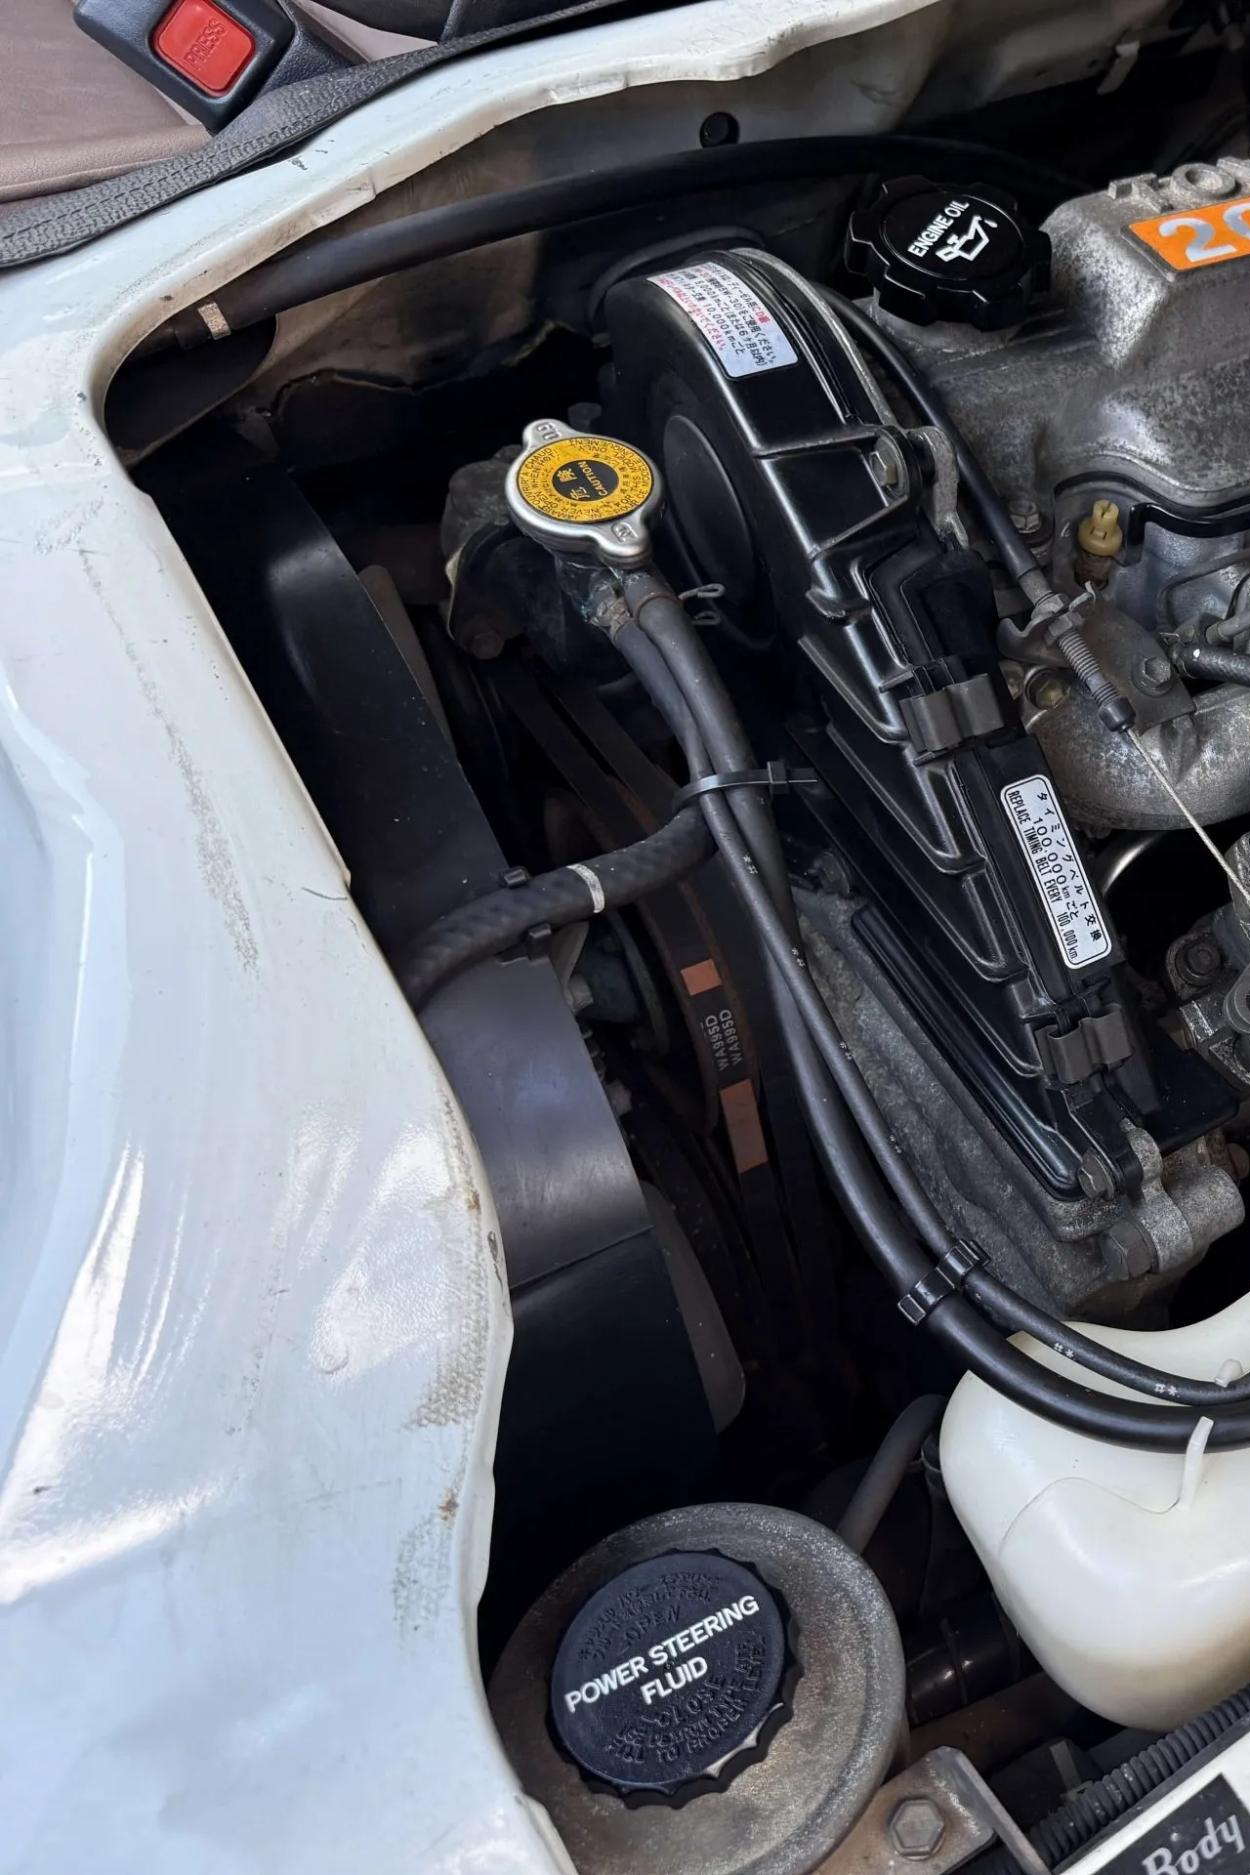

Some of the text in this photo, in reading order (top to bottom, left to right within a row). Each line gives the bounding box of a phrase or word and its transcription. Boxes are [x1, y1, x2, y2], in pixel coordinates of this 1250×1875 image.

[182, 16, 228, 71] PRESS
[907, 199, 970, 257] ENGINE OIL
[534, 490, 559, 509] OPEN
[579, 461, 608, 495] CAUTION
[1007, 789, 1030, 824] REPLACE
[1022, 826, 1042, 855] TIMING
[1034, 856, 1051, 877] BELT
[1037, 791, 1102, 941] タイミングベルト交換
[1042, 878, 1062, 904] EVERY
[719, 1009, 742, 1064] WA995D
[562, 1655, 648, 1713] POWER
[648, 1595, 760, 1666] STEERING
[639, 1657, 706, 1705] FLUID
[1142, 1814, 1245, 1875] Body
